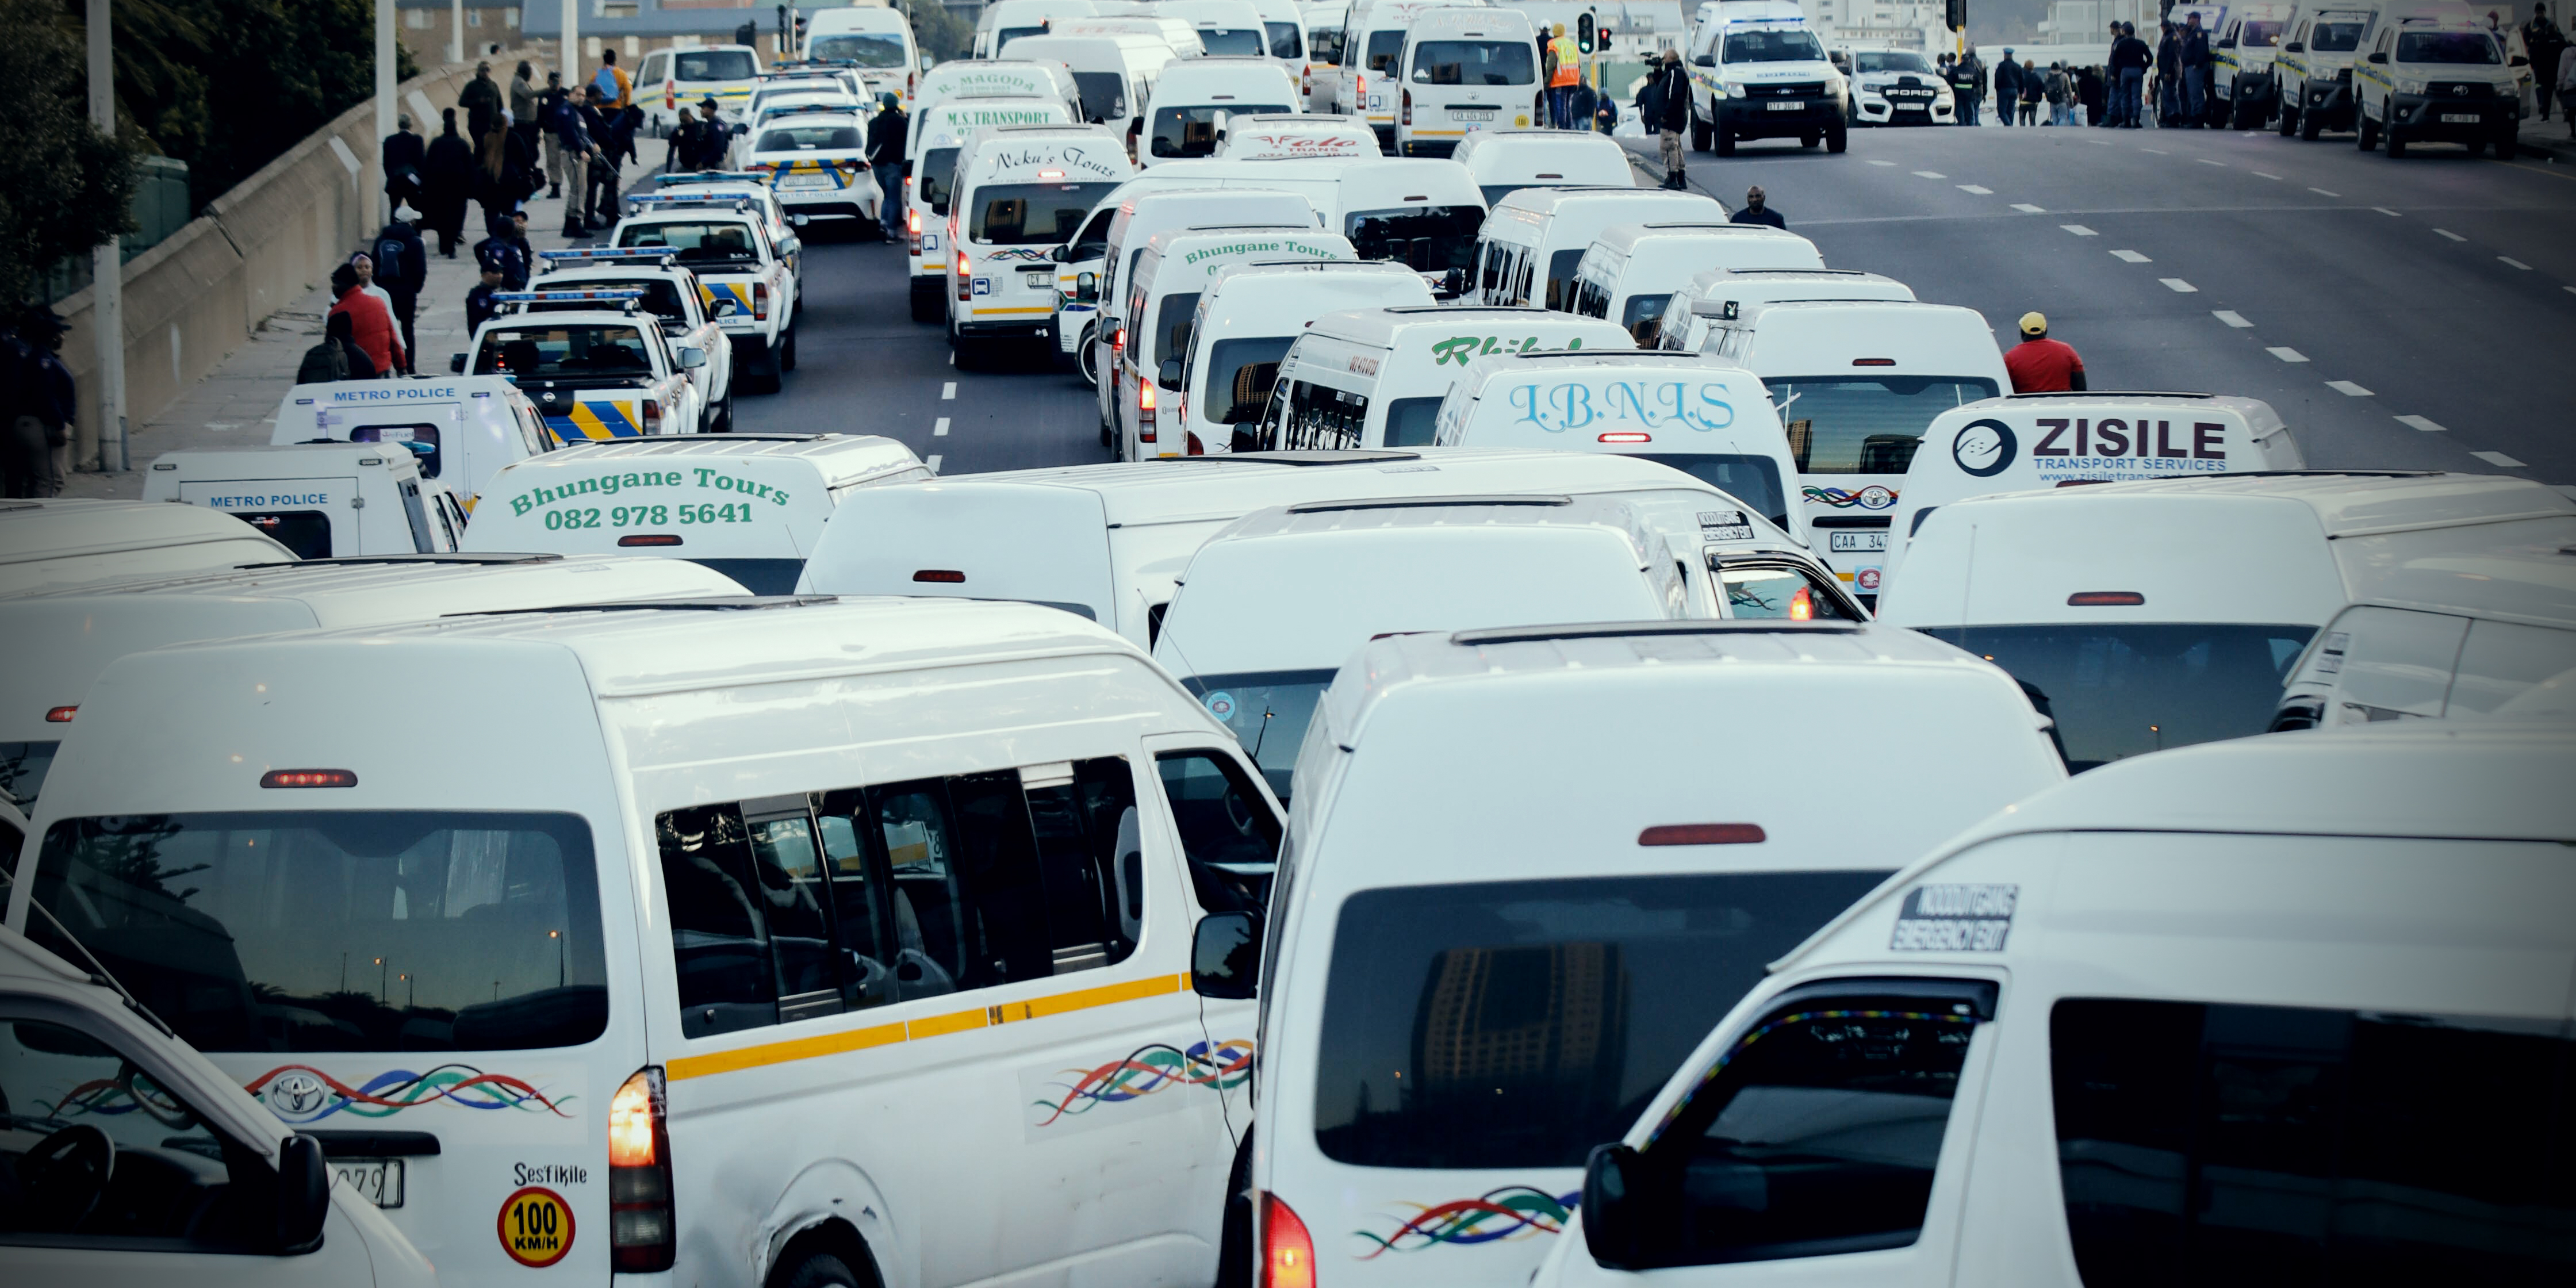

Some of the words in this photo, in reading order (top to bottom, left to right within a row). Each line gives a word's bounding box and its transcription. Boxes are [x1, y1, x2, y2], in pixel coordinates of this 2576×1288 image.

[960, 74, 1034, 92] MAGODA
[957, 127, 972, 136] 07
[1064, 147, 1116, 178] Tours
[1184, 243, 1279, 264] Bhungane
[1285, 241, 1337, 259] Tours
[335, 390, 390, 401] METRO
[397, 388, 455, 398] POLICE
[2033, 419, 2225, 459] ZISILE
[2034, 458, 2137, 469] TRANSPORT
[2143, 459, 2226, 471] SERVICES
[210, 496, 265, 507] METRO
[271, 493, 328, 505] POLICE
[509, 472, 682, 517] Bhungane
[693, 468, 790, 507] Tours
[545, 508, 601, 531] 082
[611, 505, 668, 527] 978
[679, 503, 753, 524] 5641
[1834, 535, 1856, 548] CAA
[513, 1201, 557, 1235] 100
[515, 1236, 558, 1250] KM/H
